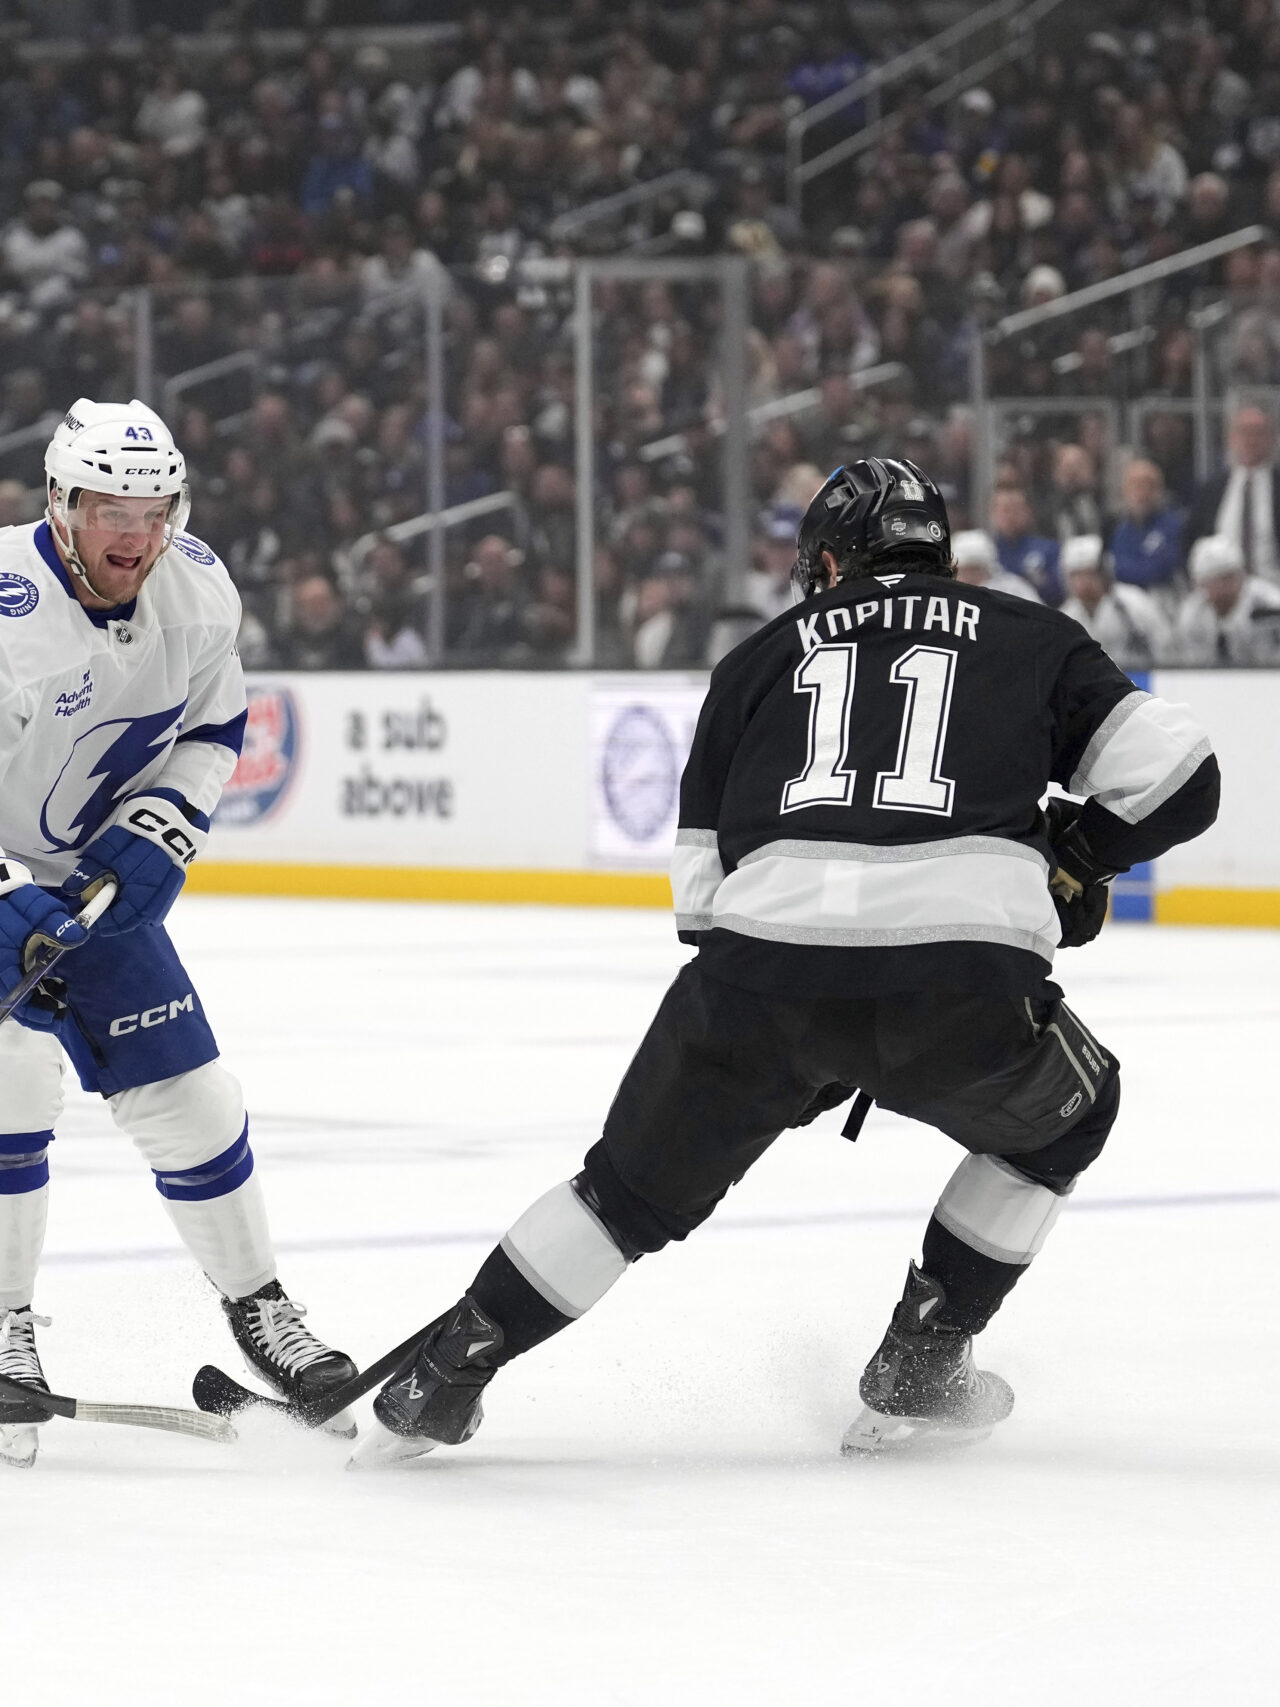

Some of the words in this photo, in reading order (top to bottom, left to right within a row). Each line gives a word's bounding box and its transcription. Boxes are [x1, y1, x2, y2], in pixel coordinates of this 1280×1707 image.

[124, 427, 153, 441] 43
[8, 574, 27, 583] BAY
[10, 582, 38, 616] LIGHTNING
[796, 595, 981, 655] KOPITAR
[54, 697, 91, 717] Health
[55, 682, 93, 704] Advent
[382, 694, 448, 752] sub
[779, 642, 959, 818] 11
[342, 760, 455, 818] above
[56, 919, 77, 937] CC
[109, 993, 195, 1037] CCM
